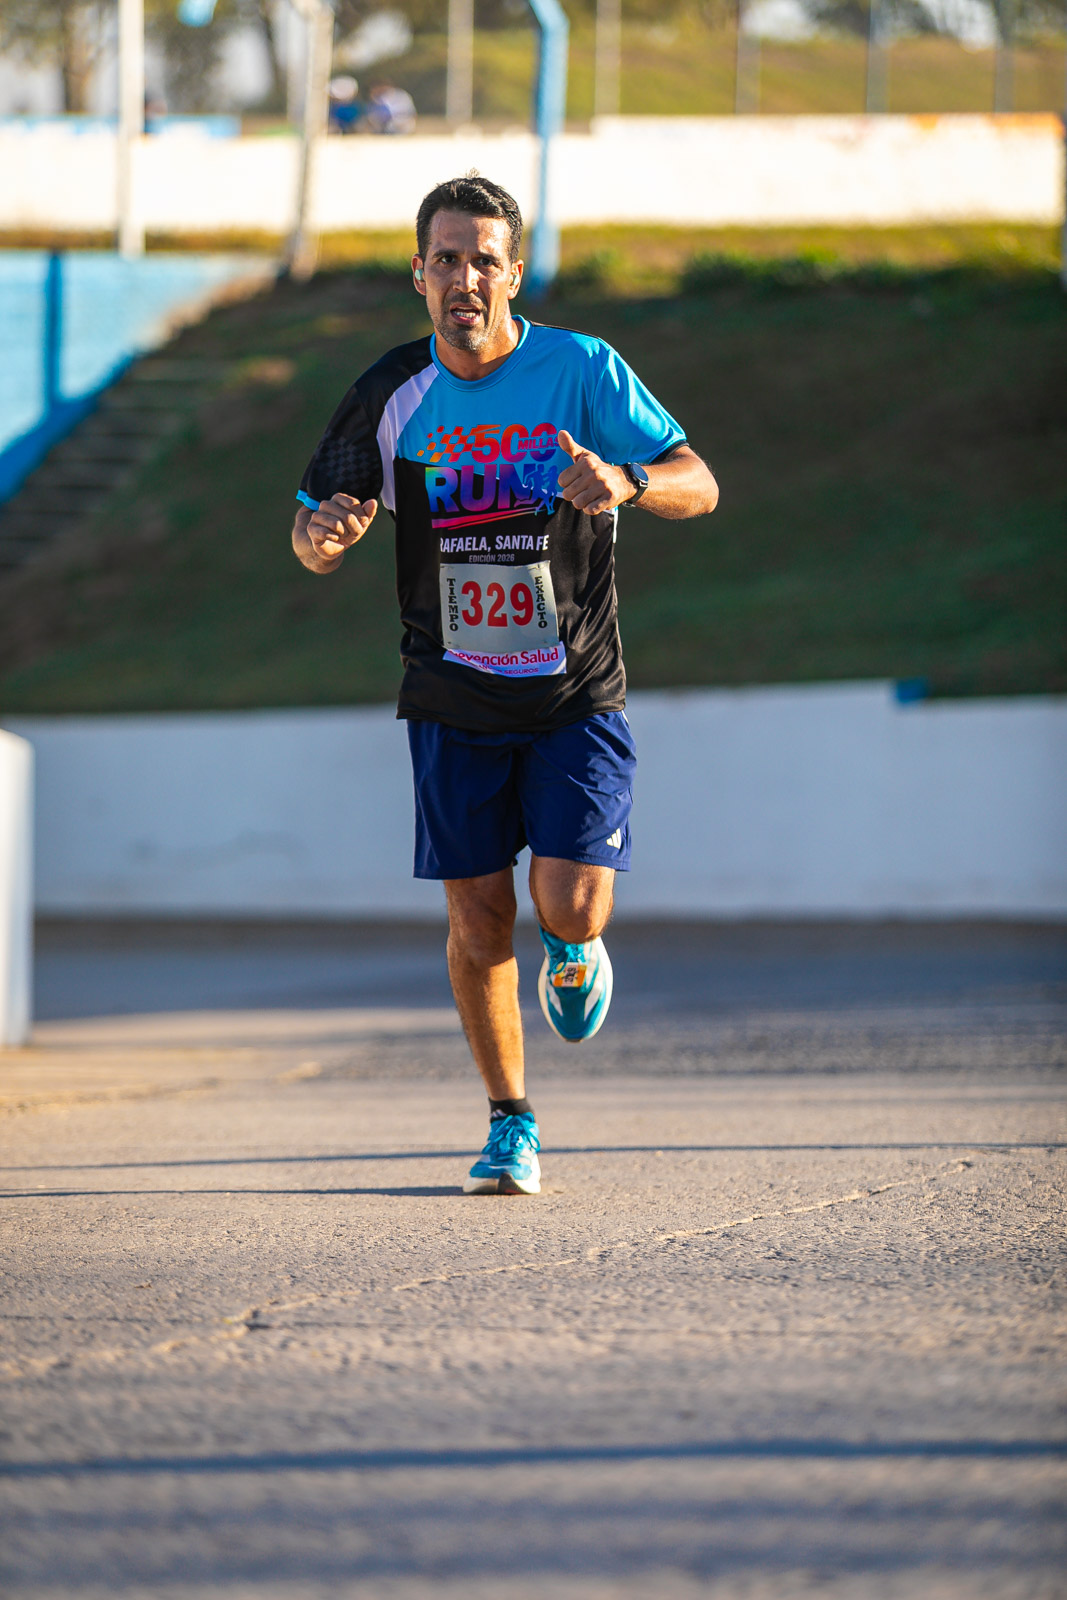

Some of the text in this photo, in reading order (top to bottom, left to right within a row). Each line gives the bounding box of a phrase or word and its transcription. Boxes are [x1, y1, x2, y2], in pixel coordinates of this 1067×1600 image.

[495, 535, 534, 550] SANTA
[536, 534, 549, 551] FE
[468, 553, 515, 563] EDICIÓN 2026
[446, 578, 459, 631] TIEMPO
[461, 580, 534, 627] 329
[534, 575, 547, 628] EXACTO
[520, 647, 559, 665] Salud
[504, 667, 539, 675] SEGUROS
